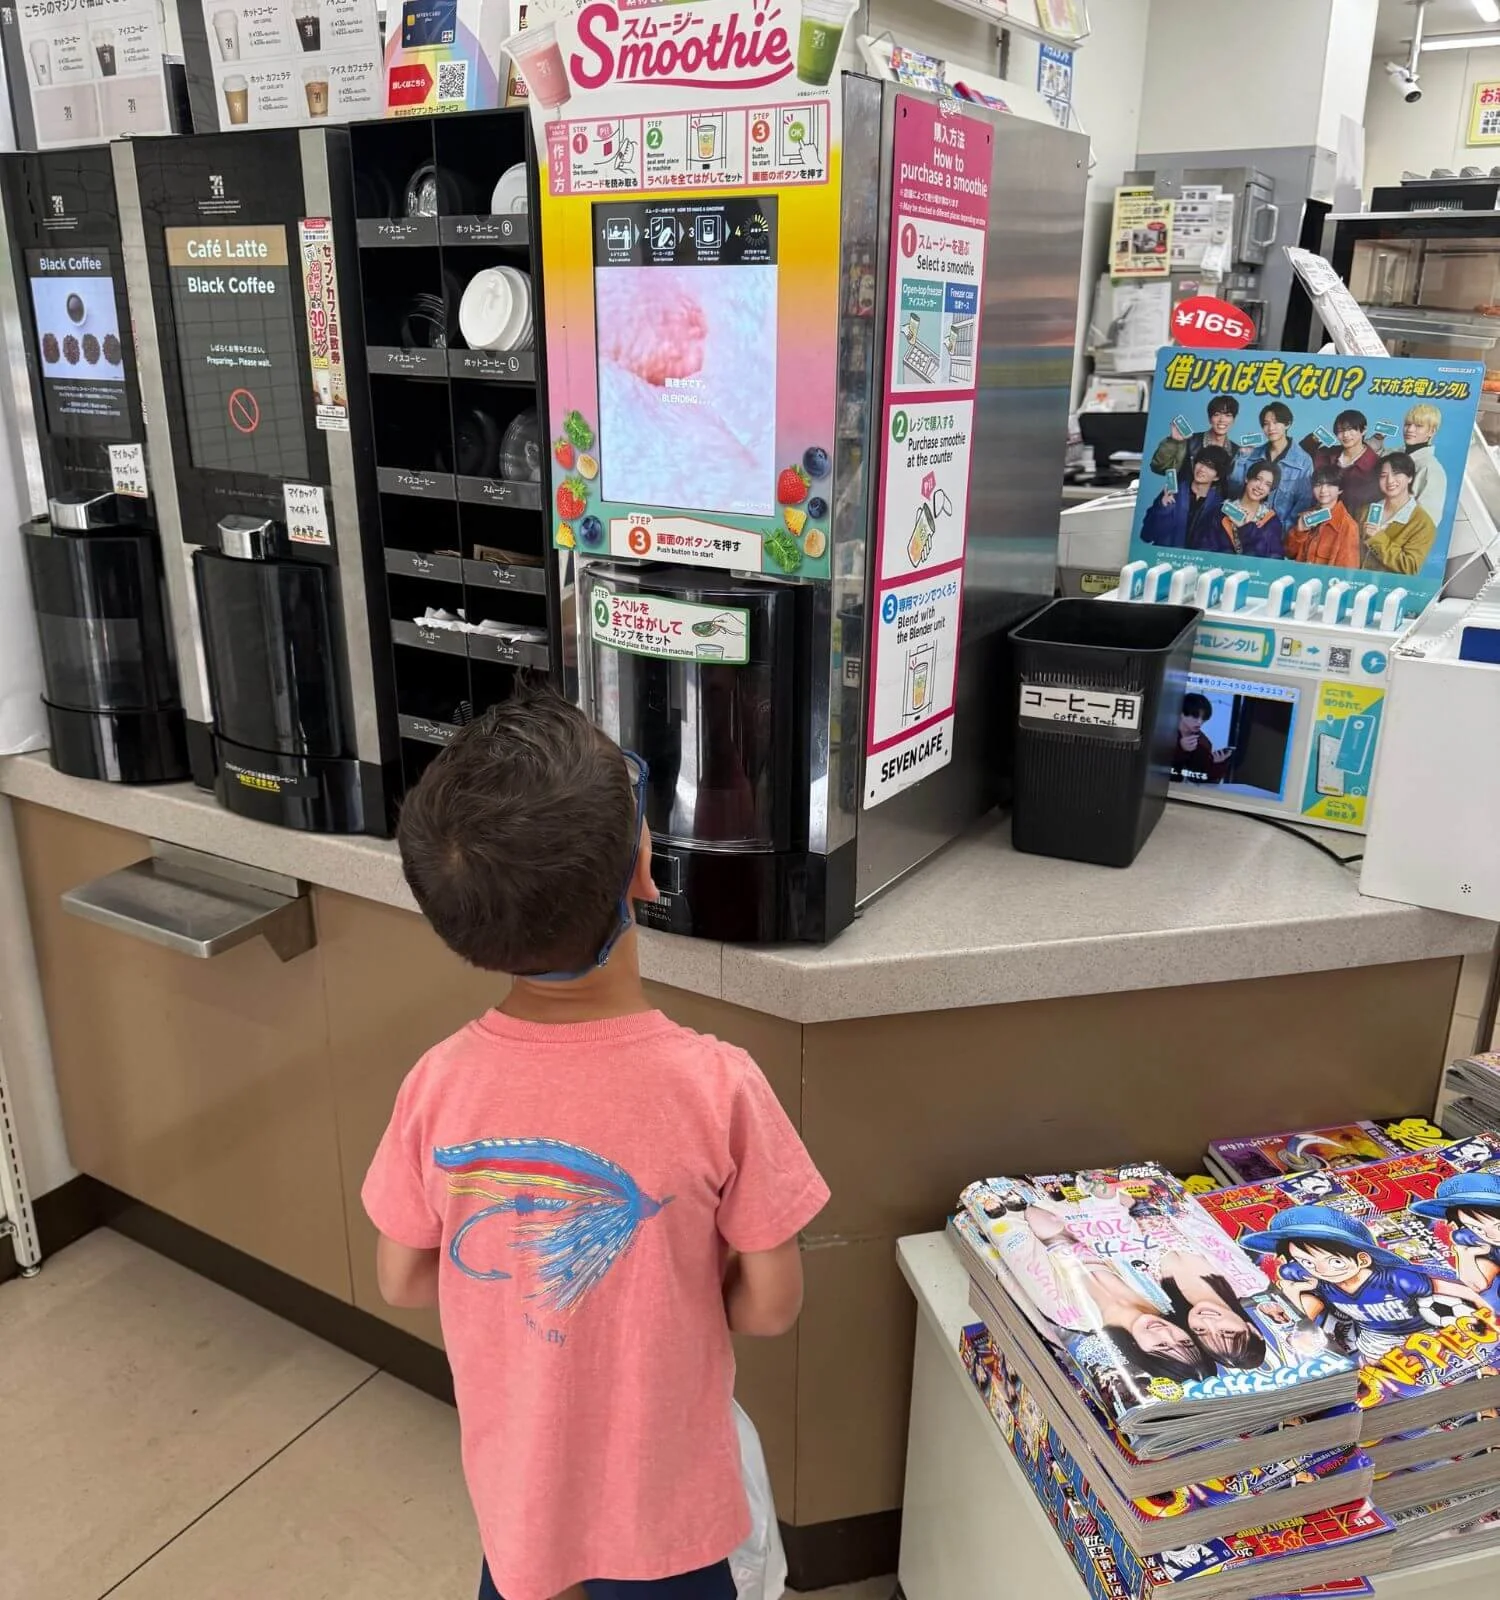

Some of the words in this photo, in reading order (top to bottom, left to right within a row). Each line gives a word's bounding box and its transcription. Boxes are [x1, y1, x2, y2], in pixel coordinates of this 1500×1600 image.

[243, 7, 278, 17] ホットコーヒー
[118, 26, 149, 35] アイスコーヒー
[623, 11, 704, 41] スムージー
[54, 36, 81, 46] ホットコーヒー
[570, 2, 792, 90] Smoothie
[330, 66, 345, 75] アイス
[347, 63, 374, 73] カフェラテ
[250, 75, 264, 83] ホット
[267, 71, 291, 82] カフェラテ
[934, 122, 965, 149] 購入方法
[933, 147, 952, 170] How
[955, 154, 964, 173] to
[553, 145, 565, 192] 作り方
[752, 169, 824, 181] 画面のボタンを押す
[574, 178, 638, 189] バーコードを読み取る
[647, 172, 742, 186] ラベルを全てはがしてセット
[901, 163, 943, 186] purchase
[945, 174, 951, 189] a
[953, 174, 988, 198] smoothie
[378, 225, 417, 234] アイスコーヒー
[456, 225, 499, 233] ホットコーヒー
[644, 229, 650, 238] 2
[689, 228, 695, 238] 3
[735, 226, 741, 236] 4
[187, 240, 220, 258] Café
[226, 240, 268, 258] Latte
[40, 257, 66, 270] Black
[69, 257, 101, 270] Coffee
[916, 255, 940, 271] Select
[941, 262, 945, 273] a
[947, 261, 974, 276] smoothie
[188, 277, 224, 293] Black
[229, 277, 275, 294] Coffee
[322, 244, 340, 365] セブンカフェ回数券
[1175, 309, 1244, 337] ¥165
[239, 357, 256, 367] Please
[388, 354, 427, 362] アイスコーヒー
[464, 359, 506, 368] ホットコーヒー
[1368, 377, 1470, 400] スマホ充電レンタル
[909, 415, 954, 432] レジで購入する
[908, 436, 938, 451] Purchase
[940, 432, 966, 448] smoothie
[112, 448, 138, 460] マイカップ
[907, 455, 915, 468] at
[917, 453, 927, 467] the
[929, 450, 953, 465] counter
[397, 476, 436, 485] アイスコーヒー
[288, 488, 317, 499] マイカップ
[483, 485, 511, 494] スムージー
[289, 505, 319, 515] マイボトル
[630, 516, 651, 525] STEP
[634, 530, 646, 551] 3
[656, 533, 742, 552] 画面のボタンを押す
[656, 546, 670, 554] Push
[671, 547, 690, 556] button
[412, 559, 434, 568] マドラー
[493, 570, 516, 579] マドラー
[594, 589, 609, 599] STEP
[899, 581, 957, 612] 専用マシンでつくろう
[612, 597, 649, 615] ラベルを
[612, 611, 682, 635] 全てはがして
[898, 610, 919, 629] Blend
[920, 605, 935, 622] with
[419, 631, 440, 640] シュガー
[612, 628, 671, 646] カップをセット
[897, 630, 908, 644] the
[909, 622, 933, 640] Blender
[934, 616, 946, 631] unit
[497, 645, 520, 655] シュガー
[650, 645, 660, 653] cup
[668, 648, 694, 656] machine
[1195, 634, 1259, 653] 電レンタル
[1025, 690, 1135, 720] コーヒー用
[881, 744, 918, 783] SEVEN
[1066, 1218, 1130, 1239] 2025
[1366, 1299, 1414, 1321] PIECE
[1267, 1516, 1307, 1533] WEEKLY
